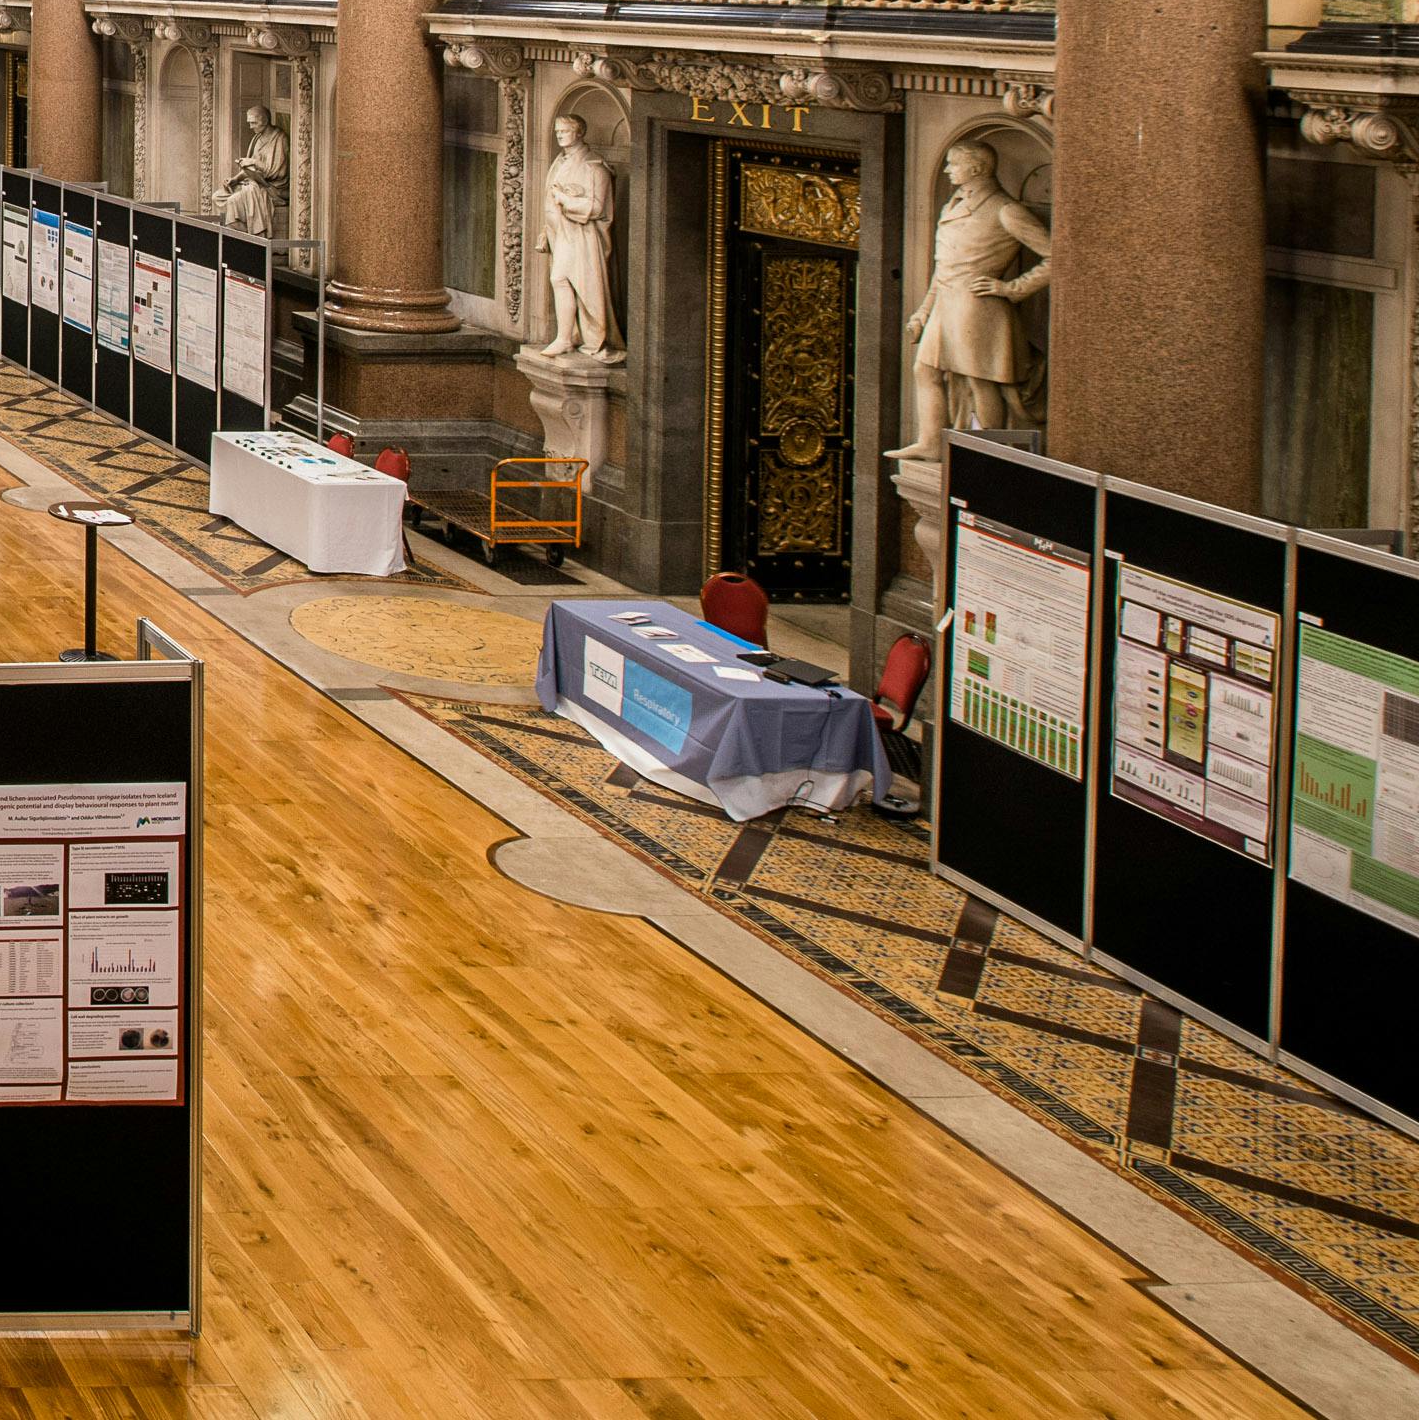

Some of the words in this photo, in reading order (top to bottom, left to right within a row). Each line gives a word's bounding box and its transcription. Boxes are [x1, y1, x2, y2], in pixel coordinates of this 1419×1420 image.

[691, 97, 809, 132] EXIT
[590, 661, 617, 690] TEVA
[633, 688, 681, 726] Respiratory
[15, 802, 41, 810] potential
[54, 802, 73, 810] display
[145, 800, 159, 808] plant
[96, 793, 119, 801] syringae
